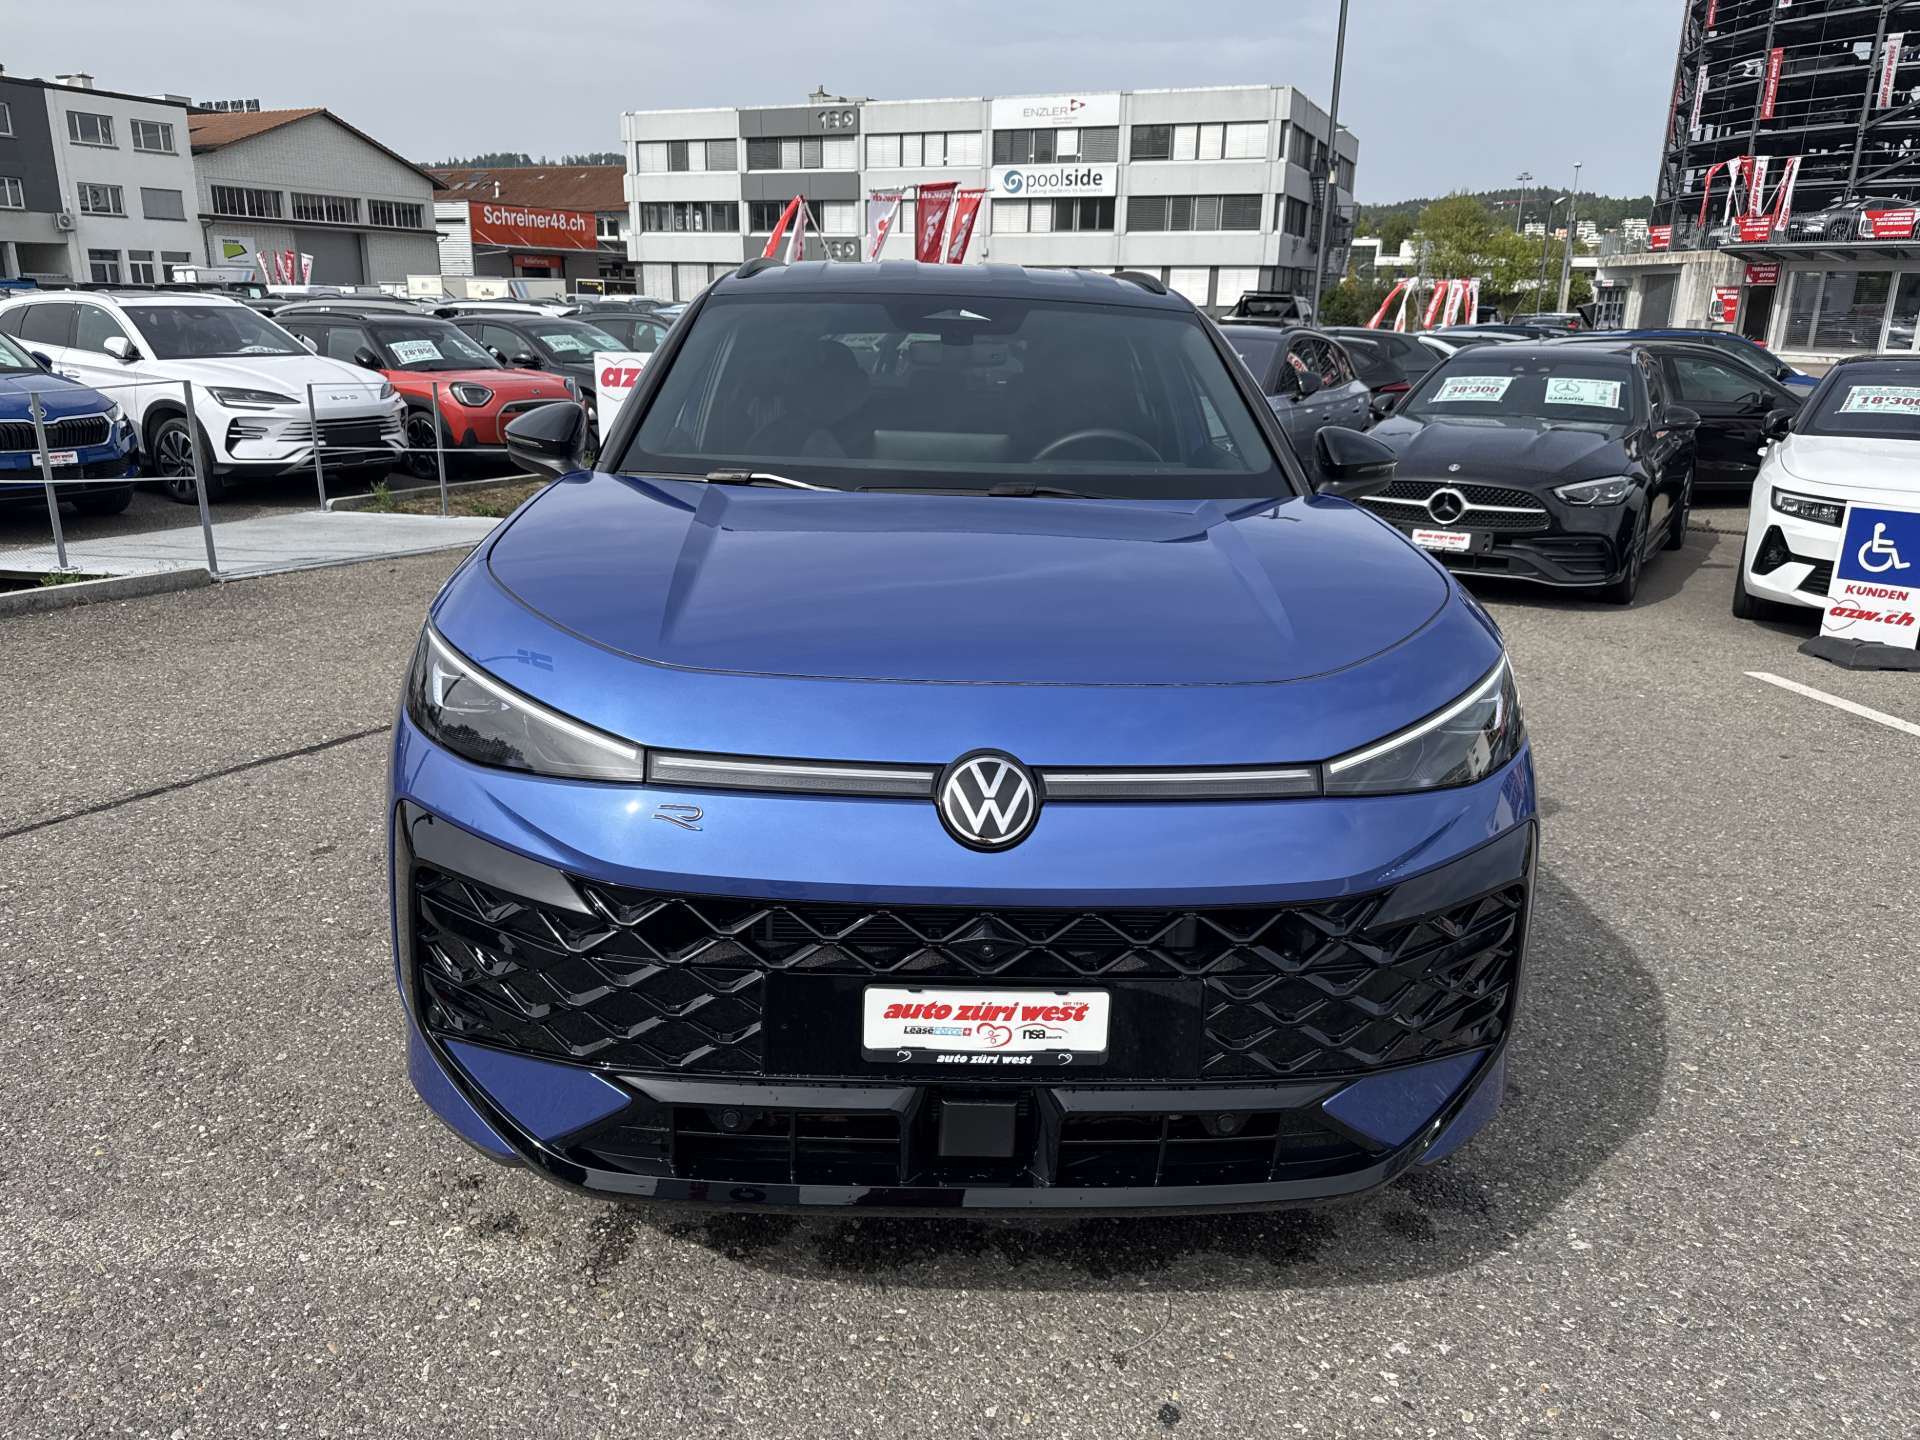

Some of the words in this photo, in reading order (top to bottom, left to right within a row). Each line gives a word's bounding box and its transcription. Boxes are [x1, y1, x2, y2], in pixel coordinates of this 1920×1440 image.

[817, 110, 854, 129] 139
[1023, 106, 1069, 118] ENZLER
[1026, 168, 1103, 194] poolside
[483, 205, 586, 231] Schreiner48.ch
[1449, 385, 1500, 394] 38'300
[1845, 584, 1909, 602] KUNDEN
[1829, 606, 1916, 626] azw.ch
[884, 1001, 952, 1019] auto
[953, 1001, 1019, 1021] züri
[1021, 1003, 1090, 1021] west
[1022, 1029, 1046, 1040] nsa
[936, 1054, 968, 1063] auto
[970, 1054, 1000, 1064] züri
[1002, 1055, 1033, 1064] west
